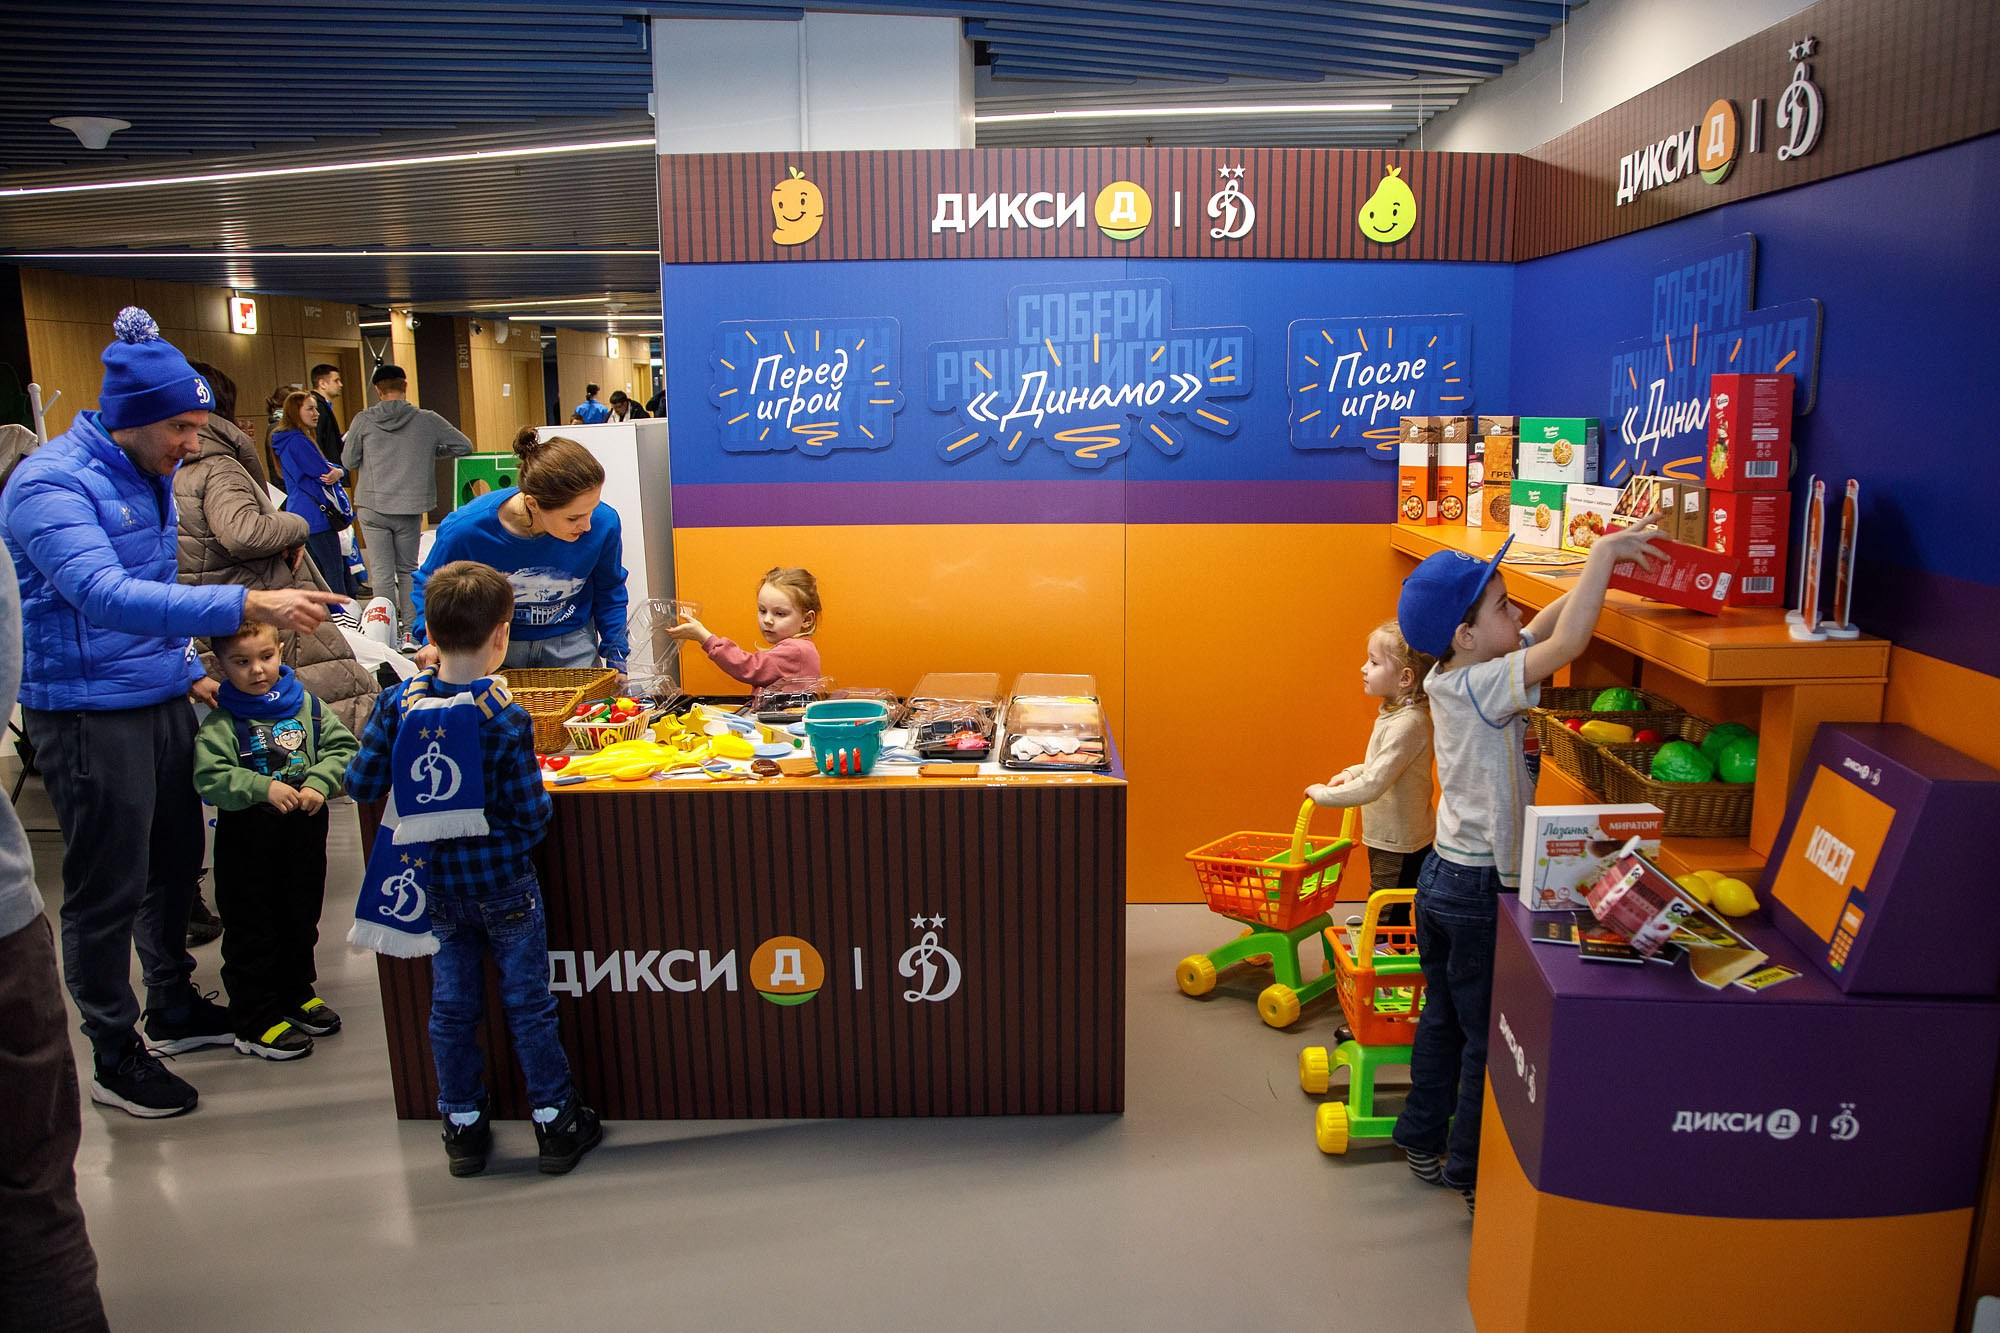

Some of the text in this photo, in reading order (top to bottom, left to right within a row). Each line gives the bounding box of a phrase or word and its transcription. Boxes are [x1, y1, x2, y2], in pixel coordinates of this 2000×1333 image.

[1617, 125, 1697, 206] ДИКСИ
[932, 191, 1085, 233] ДИКСИ
[1017, 288, 1162, 345] СОБЕРИ
[1652, 249, 1745, 344] СОБЕРИ
[750, 348, 848, 411] Перед
[936, 337, 1243, 403] РАЦИОН ИГРОКА
[1328, 351, 1427, 392] После
[757, 381, 843, 429] игрой
[966, 370, 1203, 432] «Динамо»
[1341, 388, 1416, 426] игры
[1543, 822, 1589, 839] Лазанья
[1609, 820, 1660, 831] МИРАТОРГ
[1804, 825, 1856, 886] КАССА
[547, 948, 738, 997] ДИКСИ
[1672, 1110, 1763, 1133] ДИКСИ
